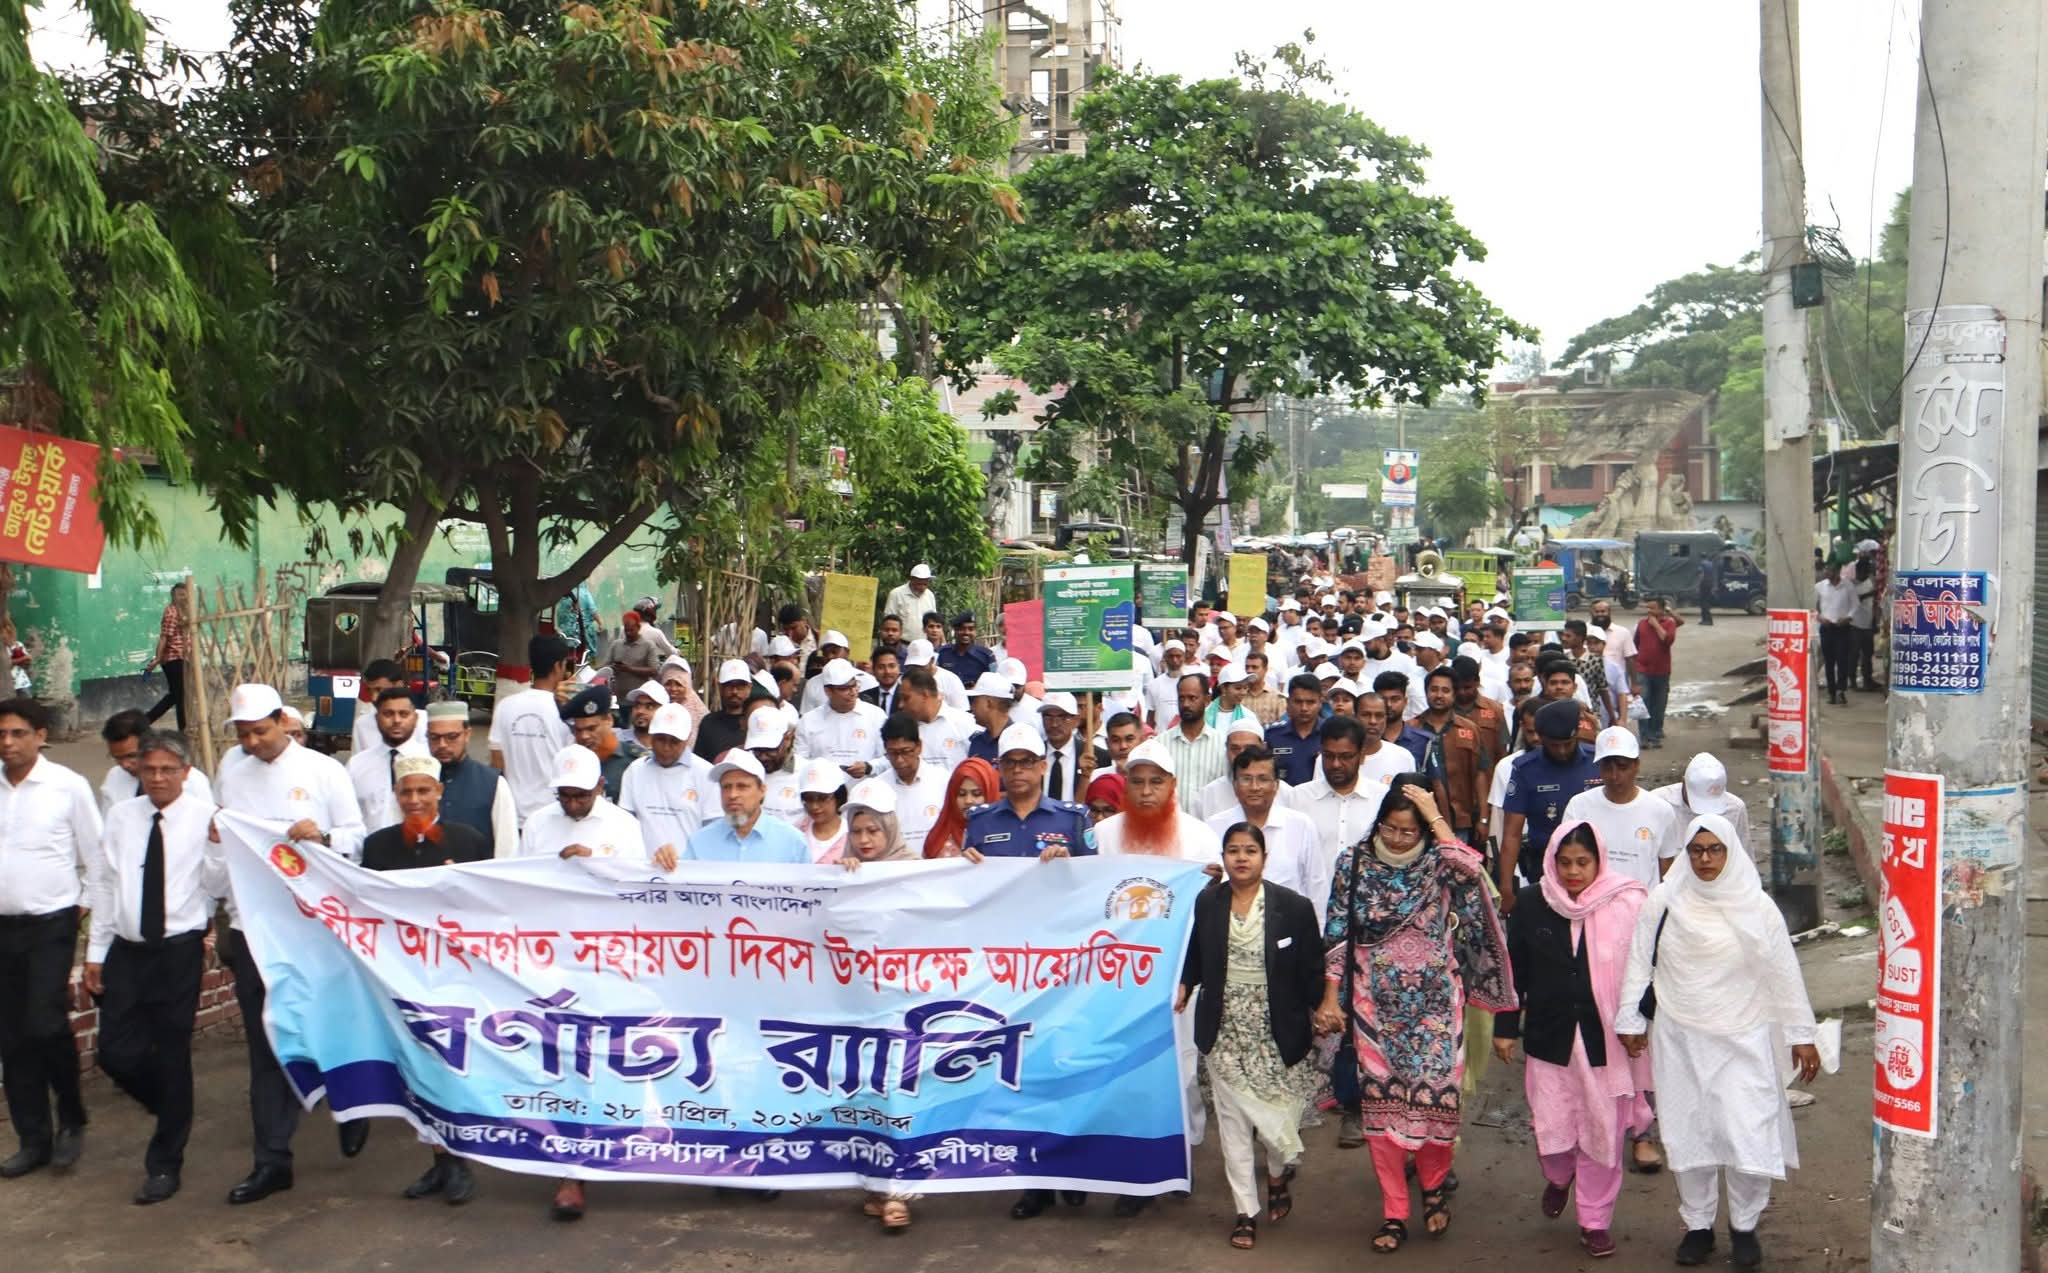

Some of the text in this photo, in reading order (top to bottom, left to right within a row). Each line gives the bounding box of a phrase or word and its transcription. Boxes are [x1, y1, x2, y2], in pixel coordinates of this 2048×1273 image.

[24, 441, 67, 557] নেটওয়ার্ক
[1893, 651, 1980, 663] 1718-811118
[1892, 663, 1980, 675] 1990-243577
[1893, 675, 1980, 687] 1816-632619
[672, 890, 725, 907] আগে
[1887, 906, 1908, 941] GST
[394, 914, 560, 977] আইনগত
[569, 923, 718, 982] সহায়তা
[724, 916, 817, 983] দিবস
[823, 929, 974, 993] উপলক্ষে
[982, 929, 1164, 993] আয়োজিত
[1888, 963, 1918, 984] SUST
[604, 1102, 643, 1120] ২৮
[541, 1132, 618, 1160] জেলা
[625, 1132, 730, 1164] লিগ্যাল
[740, 1137, 814, 1164] এইড
